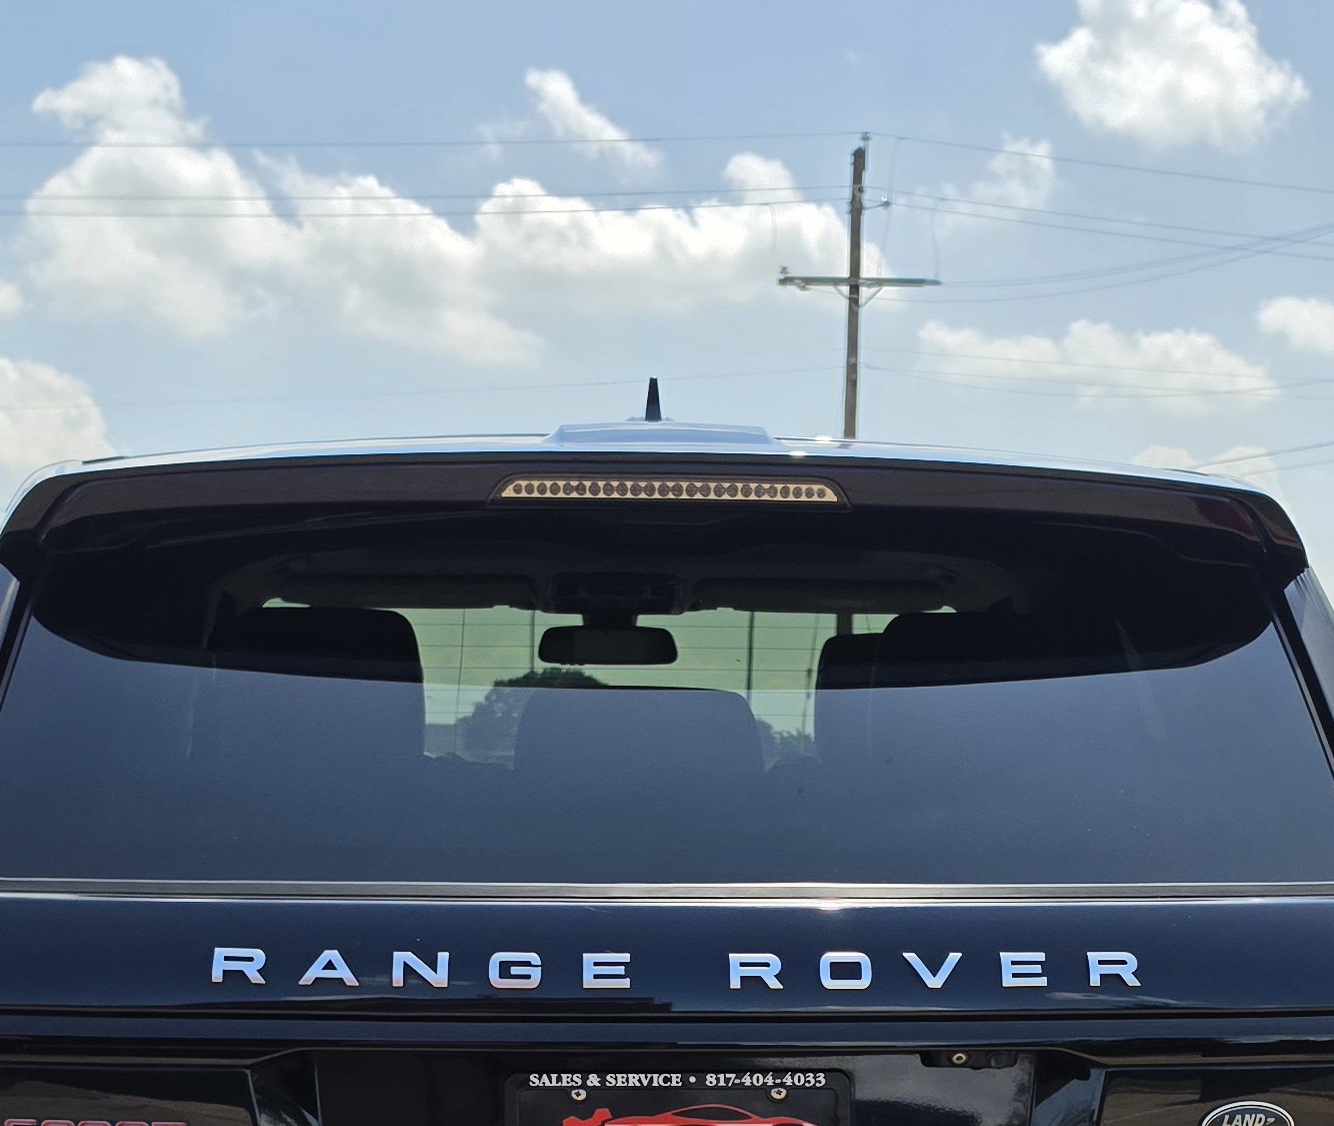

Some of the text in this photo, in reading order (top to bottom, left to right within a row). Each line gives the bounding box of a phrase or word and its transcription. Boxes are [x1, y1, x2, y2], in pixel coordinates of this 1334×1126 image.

[212, 947, 1141, 990] RANGE ROVER
[529, 1073, 826, 1087] SALES & SERVICE 817-404-4033
